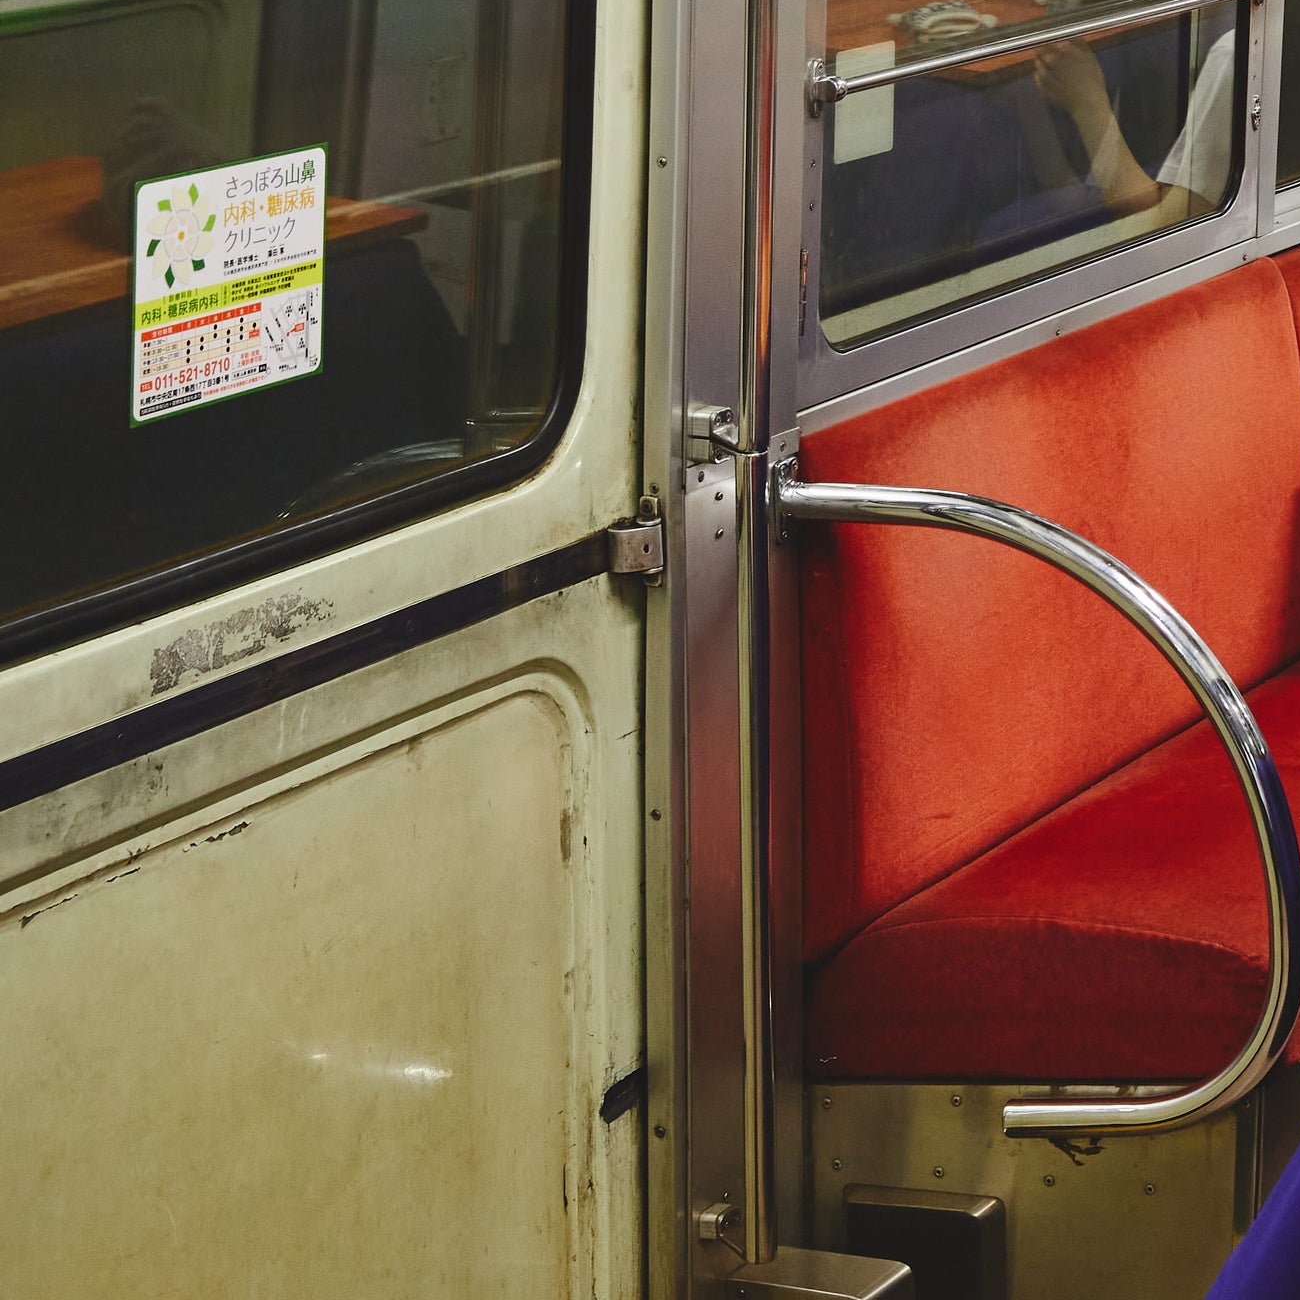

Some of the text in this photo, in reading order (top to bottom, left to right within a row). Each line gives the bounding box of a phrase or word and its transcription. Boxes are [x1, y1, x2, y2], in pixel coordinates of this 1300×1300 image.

[226, 159, 316, 199] さっぽろ山鼻
[223, 186, 316, 228] 内科・糖尿病
[224, 217, 296, 253] クリニック
[141, 293, 219, 326] 内科・糖尿病内科
[154, 357, 231, 391] 011-521-8710
